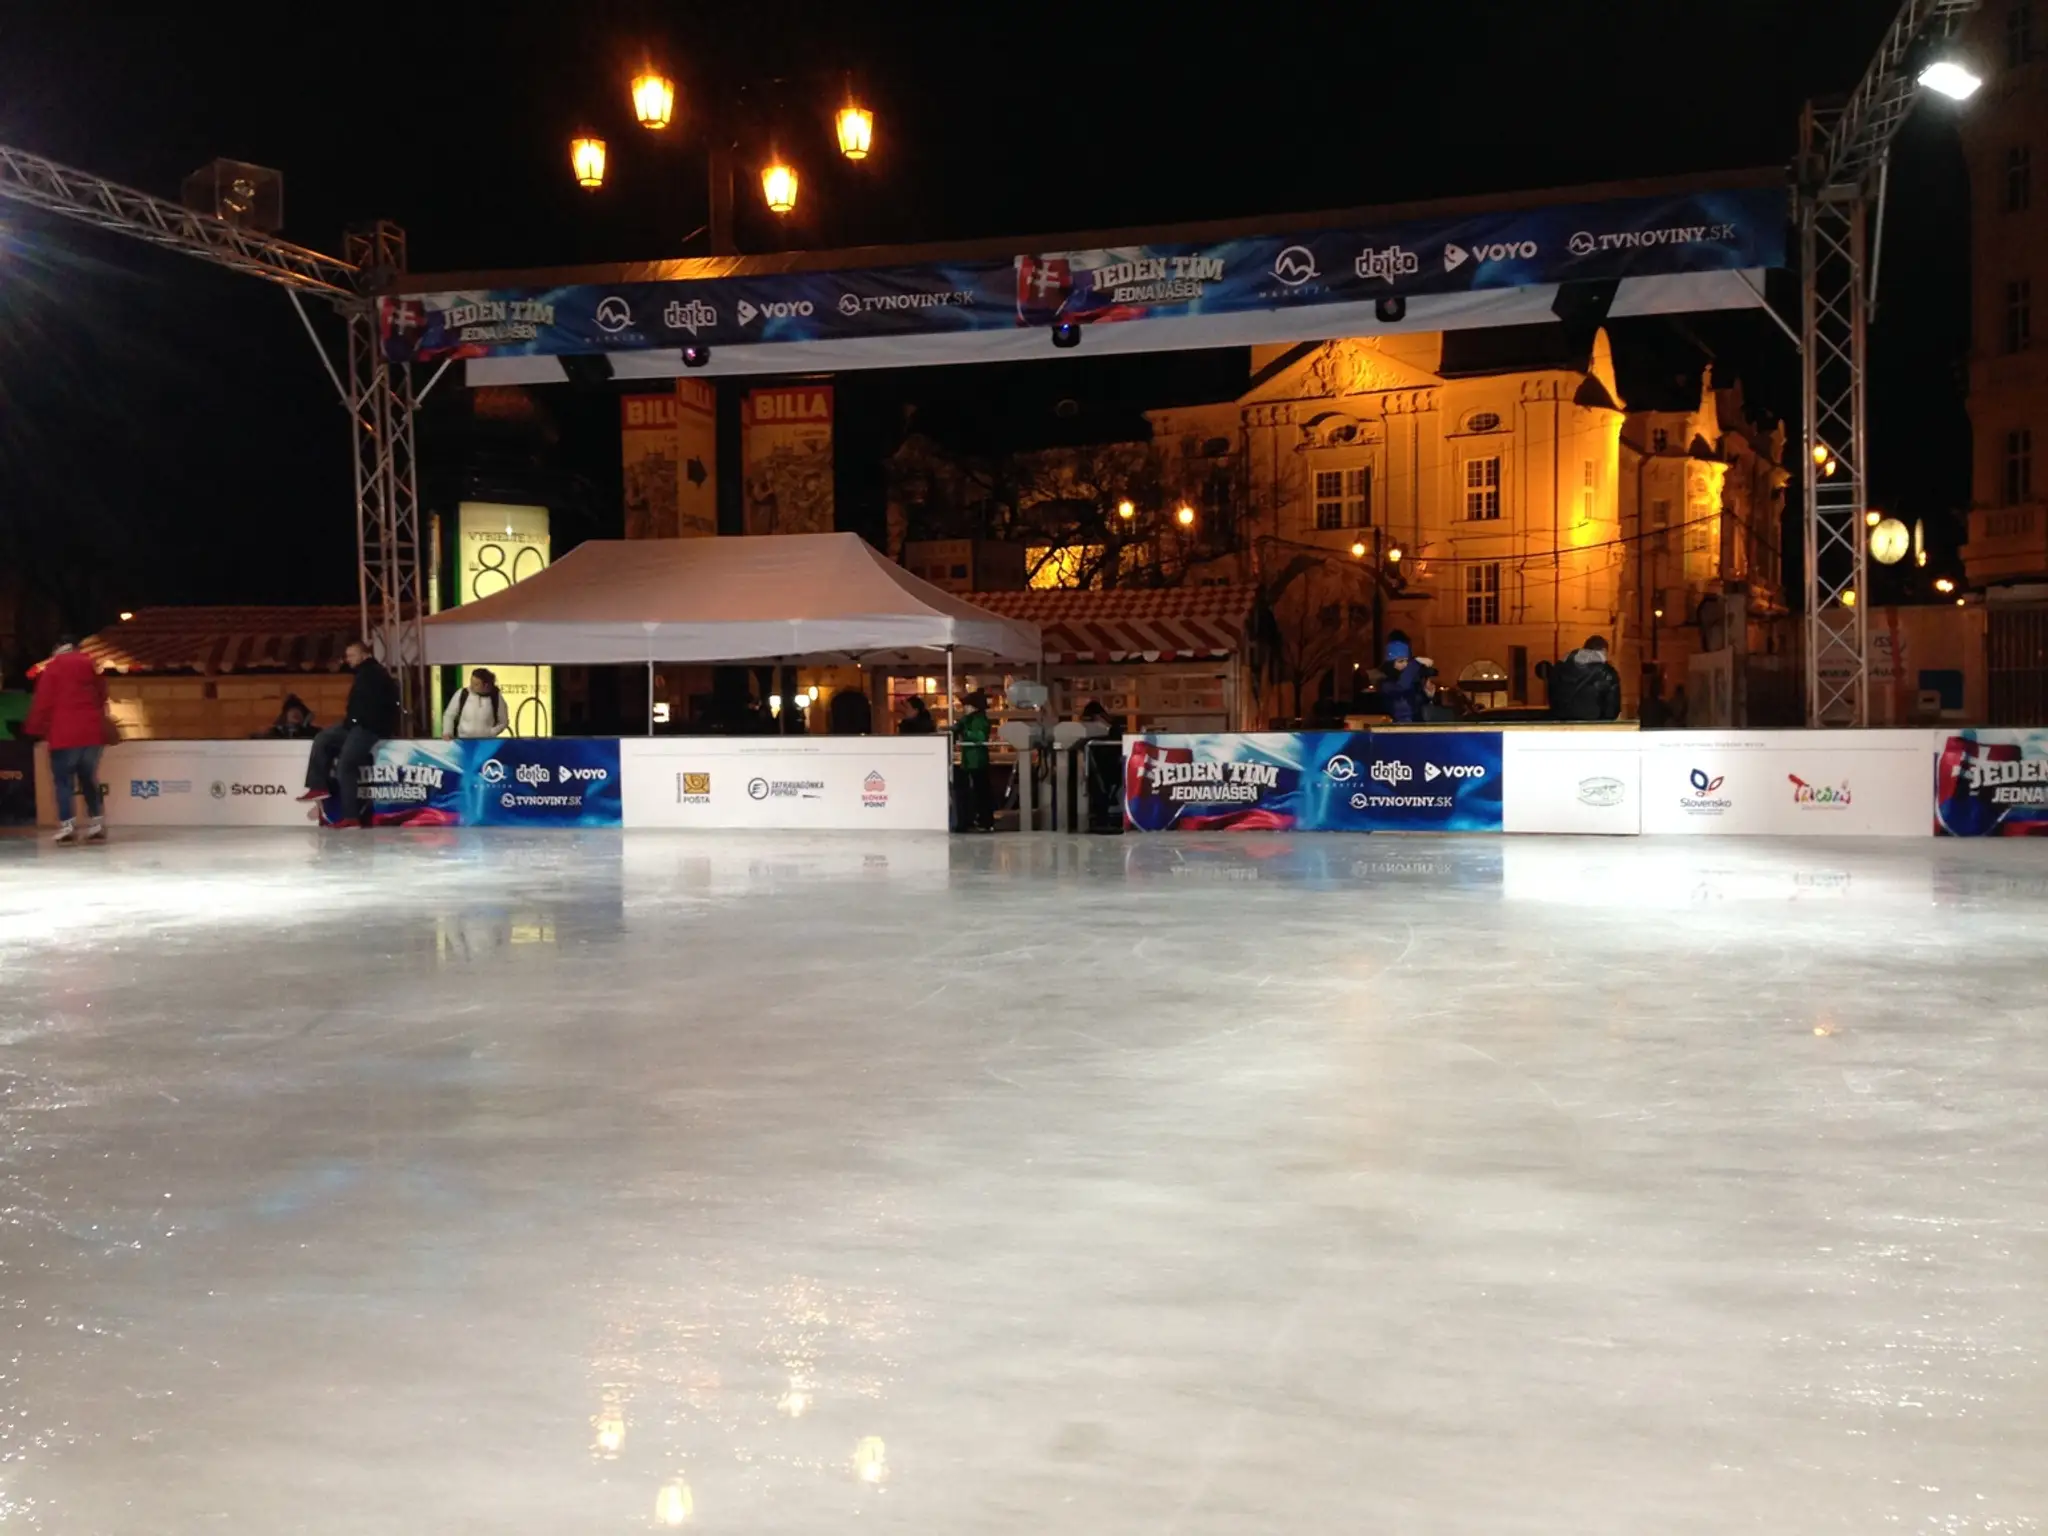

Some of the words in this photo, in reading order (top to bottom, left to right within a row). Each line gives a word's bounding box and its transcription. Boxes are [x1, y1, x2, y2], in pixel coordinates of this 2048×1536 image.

[1598, 223, 1737, 251] TVNOVINY.SK
[1472, 240, 1538, 263] VOYO
[1092, 257, 1168, 292] JEDEN
[1172, 251, 1225, 281] TÍM
[760, 300, 813, 319] VOYO
[863, 290, 975, 311] TVNOVINY.SK
[443, 301, 506, 330] JEDEN
[510, 298, 555, 325] TÍM
[626, 400, 677, 425] BILL
[755, 393, 828, 420] BILLA
[357, 764, 399, 783] DEN
[401, 761, 444, 789] TÍM
[573, 769, 607, 780] VOYO
[1151, 761, 1224, 788] JEDEN
[1227, 758, 1280, 788] TÍM
[1443, 765, 1486, 778] VOYO
[231, 783, 288, 796] ŠKODA
[357, 786, 390, 799] EDNA
[1169, 785, 1213, 802] JEDNA
[1991, 786, 2045, 804] JEDNA
[515, 795, 583, 806] TVNOVINY.SK
[1369, 796, 1453, 807] TVNOVINY.SK
[1680, 797, 1733, 808] Slovensko
